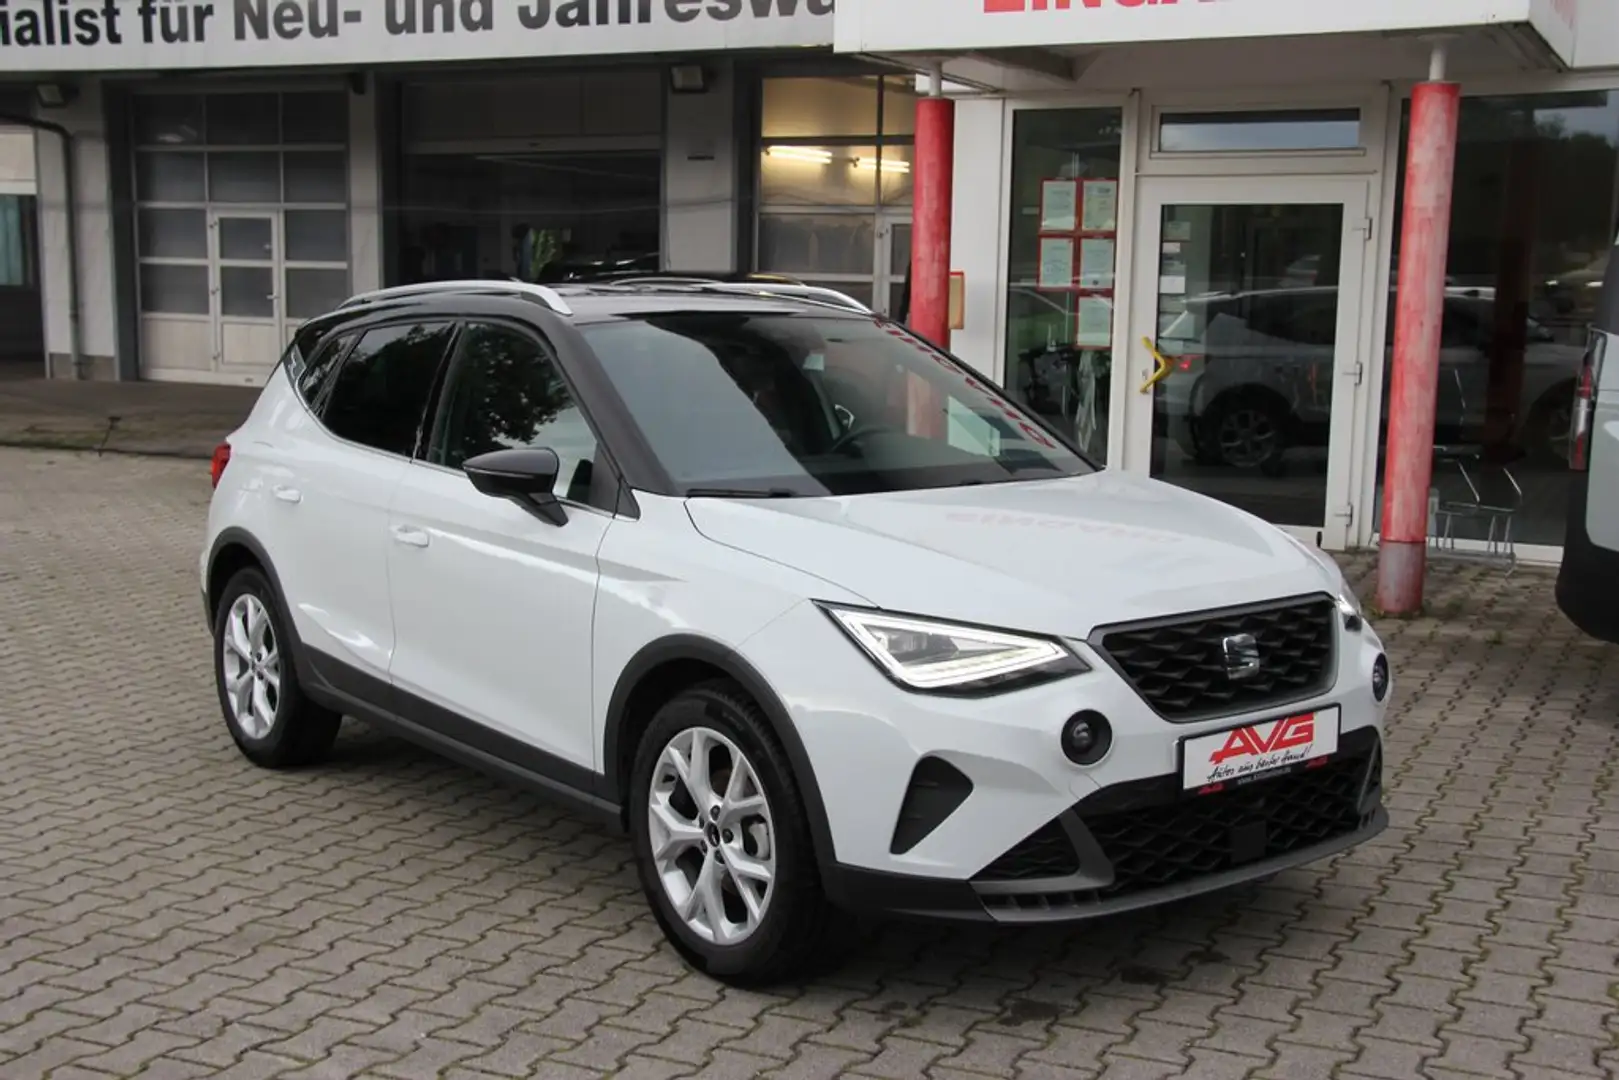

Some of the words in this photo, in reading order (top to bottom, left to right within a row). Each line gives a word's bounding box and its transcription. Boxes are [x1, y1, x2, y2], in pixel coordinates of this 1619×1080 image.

[138, 0, 214, 43] für
[234, 0, 362, 40] Neu-
[384, 0, 494, 35] und
[1208, 712, 1315, 765] AVG
